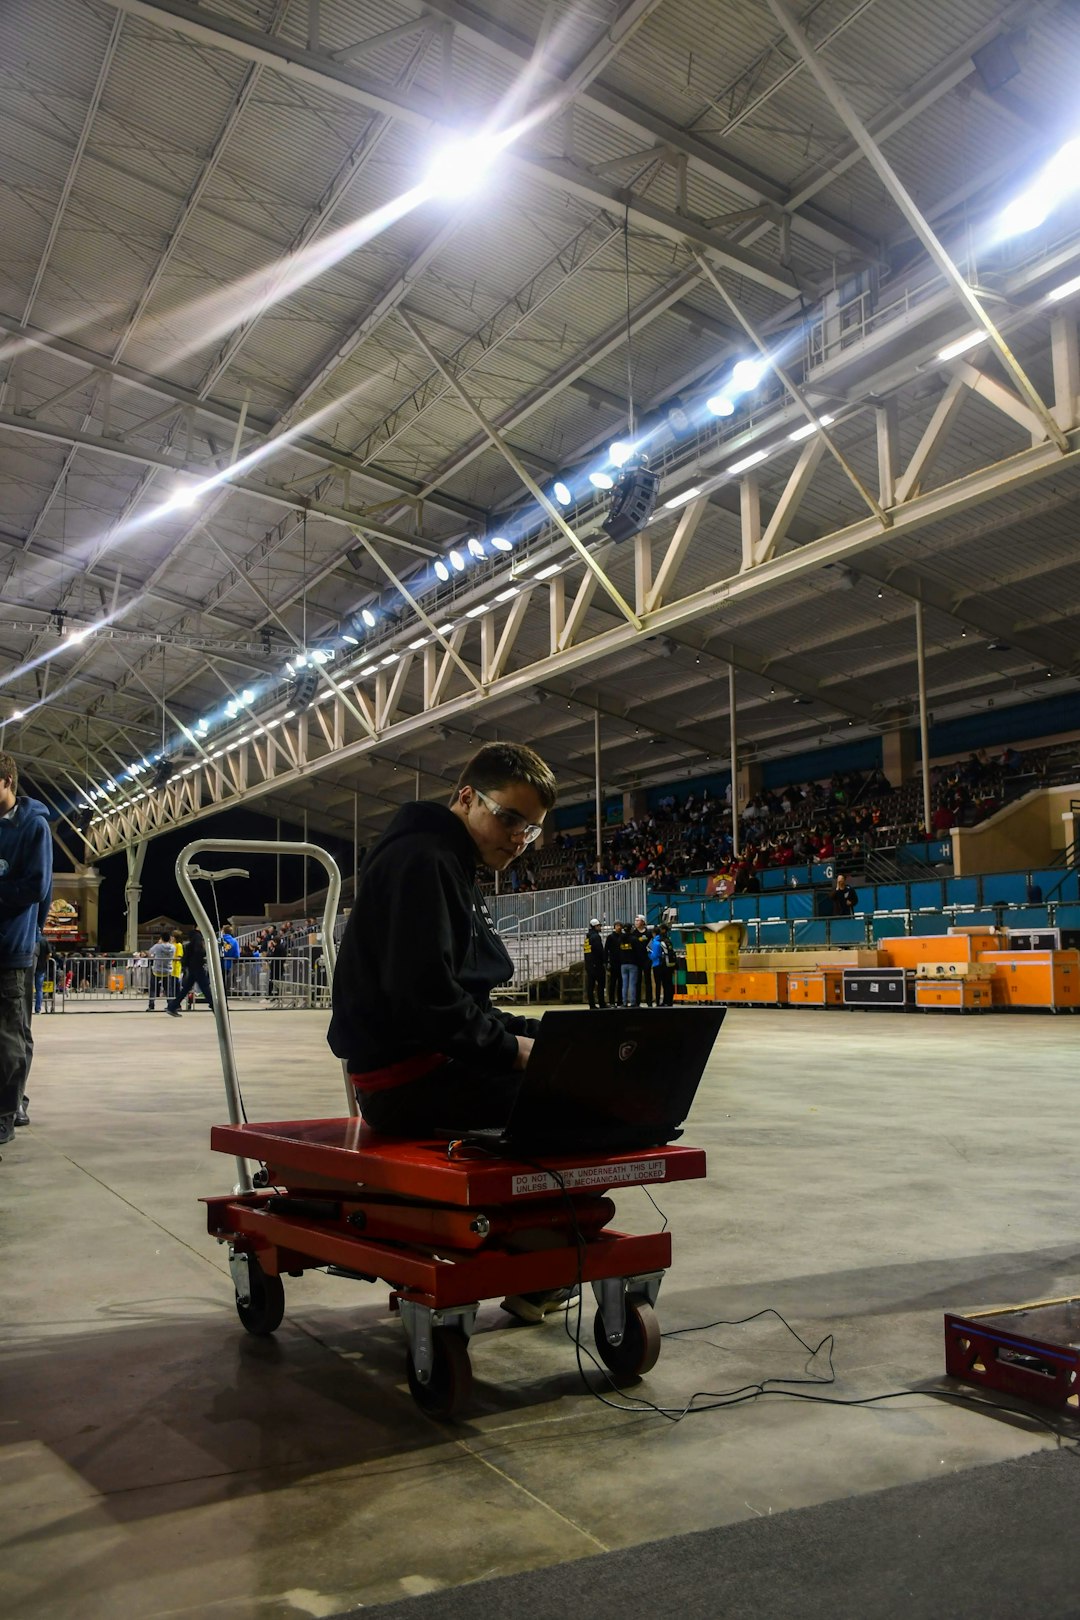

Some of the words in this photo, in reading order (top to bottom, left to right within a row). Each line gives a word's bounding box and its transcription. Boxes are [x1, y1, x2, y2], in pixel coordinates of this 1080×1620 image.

[943, 844, 949, 856] H
[825, 866, 833, 878] G
[516, 1176, 528, 1184] DO
[532, 1174, 547, 1183] NOT
[578, 1166, 626, 1177] UNDERNEATH
[630, 1163, 646, 1172] THIS
[648, 1161, 662, 1170] LIFT
[516, 1183, 547, 1193] UNLESS
[575, 1174, 630, 1185] MECHANICALLY
[634, 1170, 663, 1180] LOCKED
